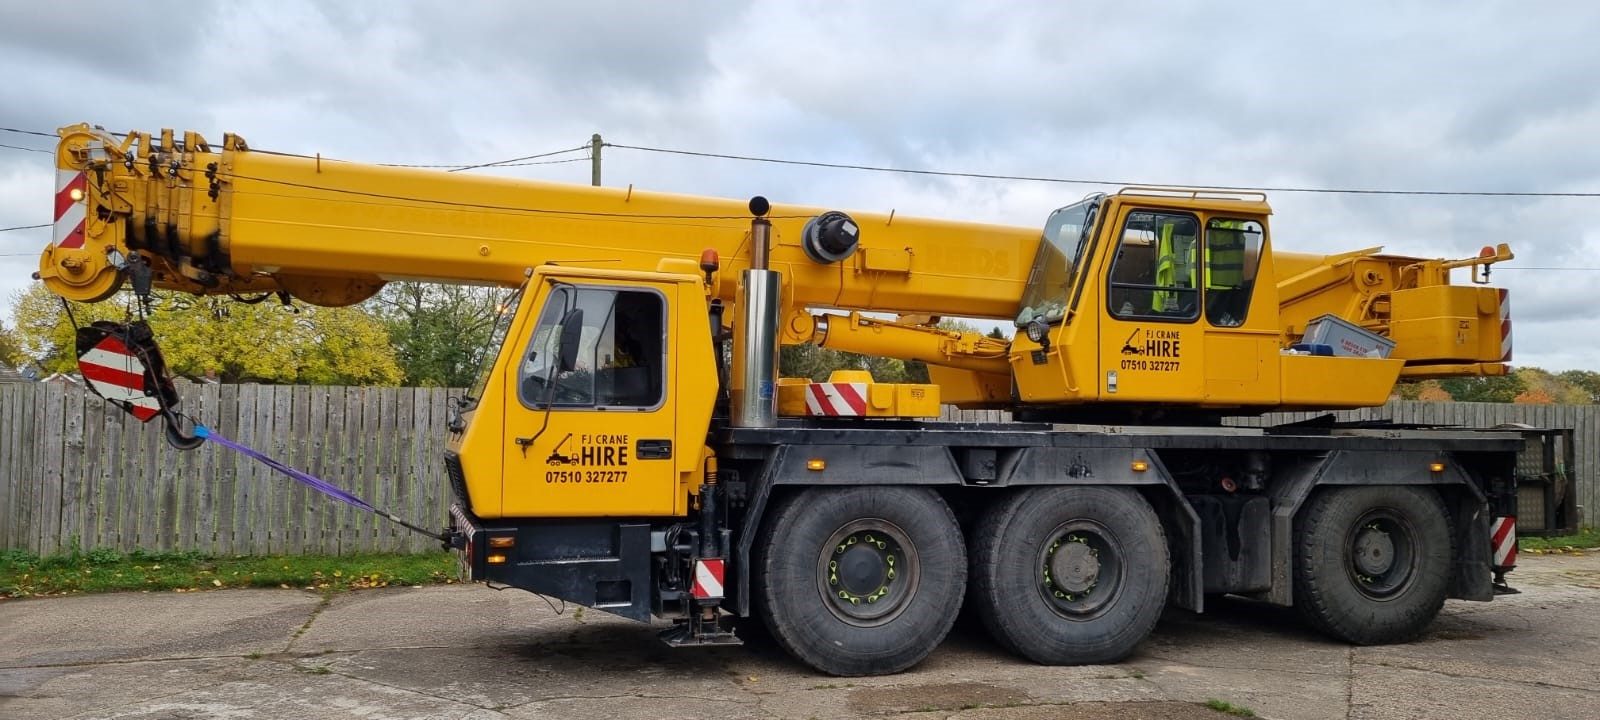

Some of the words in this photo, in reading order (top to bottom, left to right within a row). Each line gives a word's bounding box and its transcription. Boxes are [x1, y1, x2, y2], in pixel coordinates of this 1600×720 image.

[1146, 330, 1154, 339] FJ
[1156, 330, 1180, 340] CRANE
[1146, 340, 1180, 358] HIRE
[1121, 360, 1147, 371] 07510
[1149, 361, 1180, 372] 327277
[582, 435, 592, 445] FJ
[596, 435, 628, 445] CRANE
[582, 446, 628, 466] HIRE
[546, 471, 581, 484] 07510
[586, 471, 628, 484] 327277
